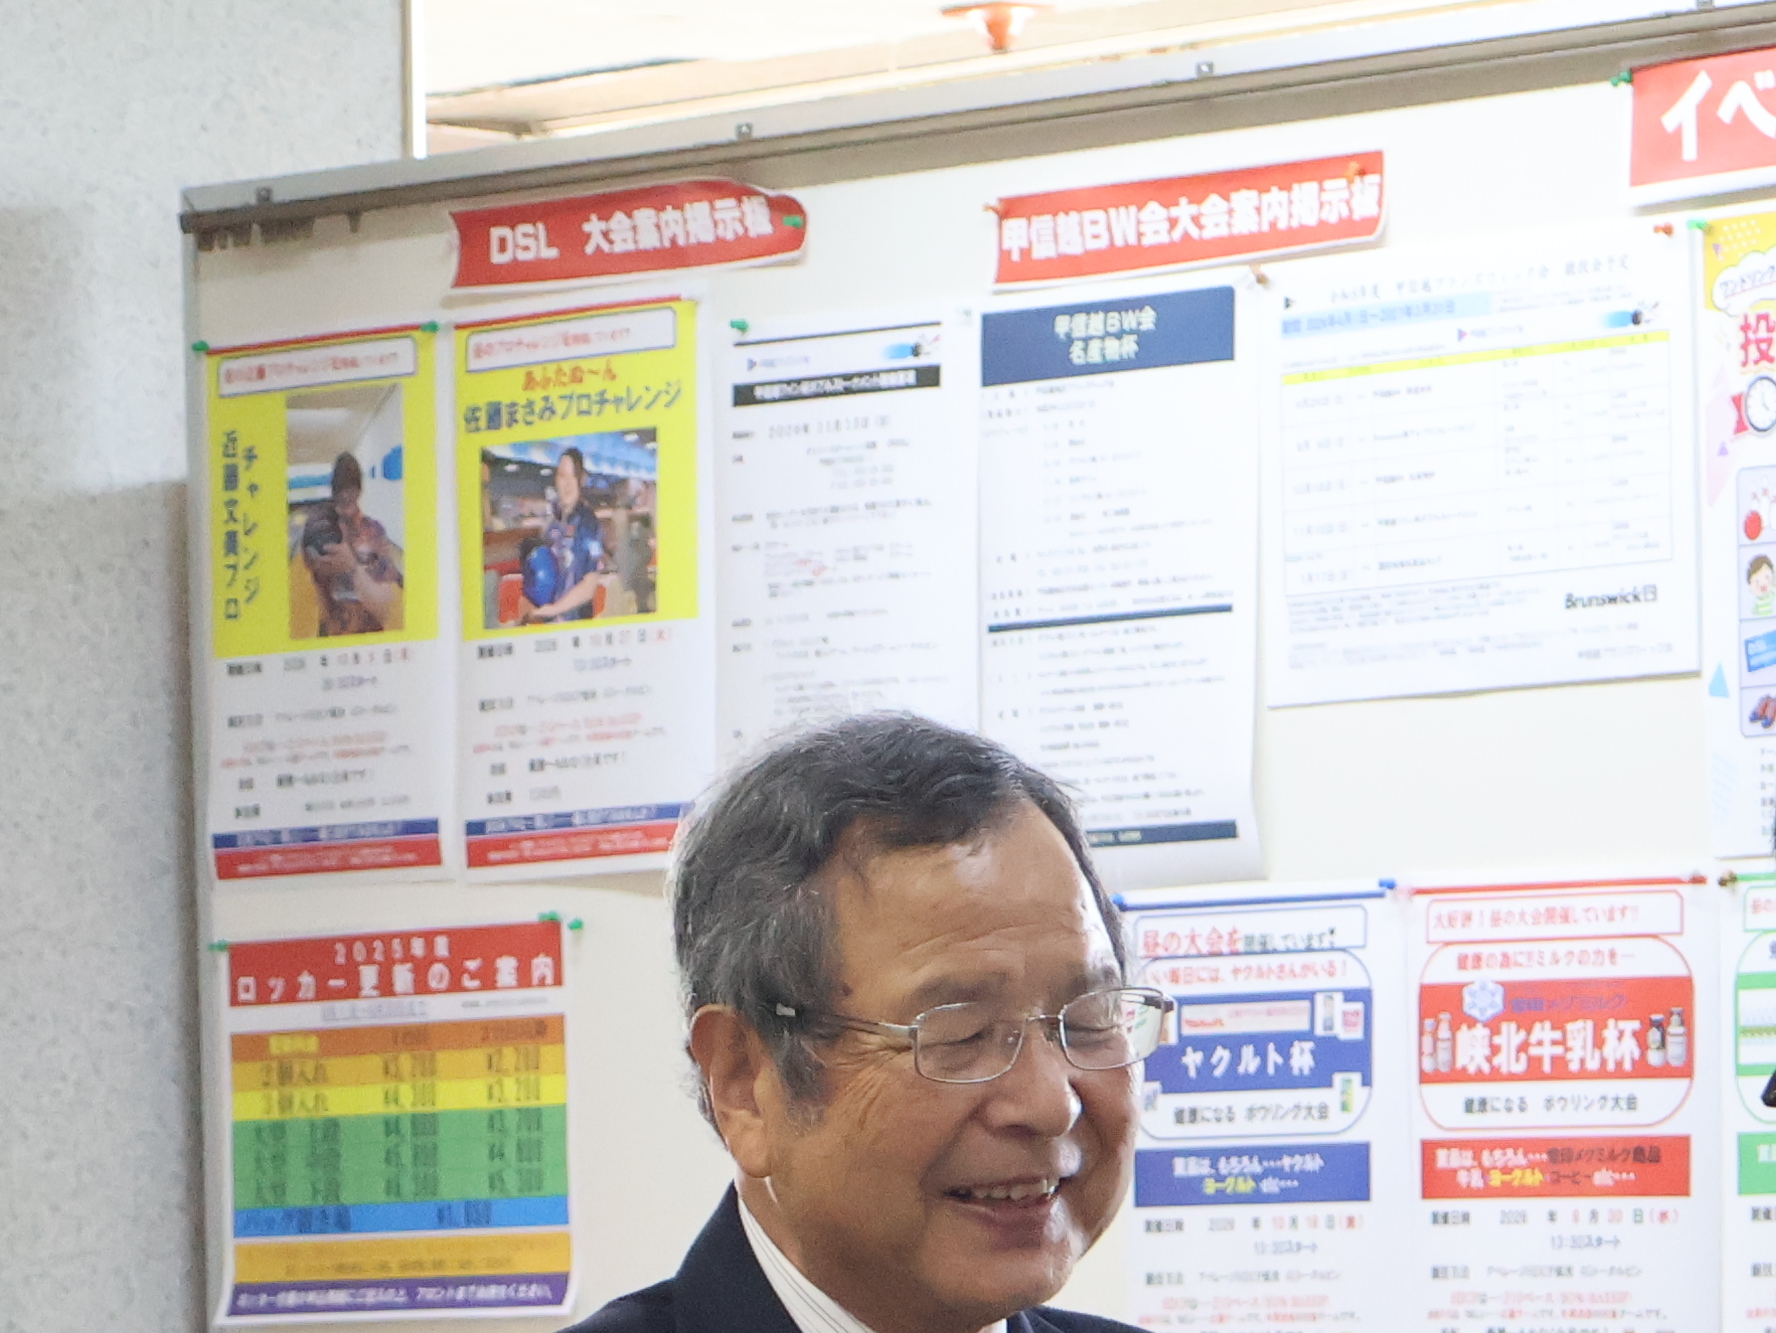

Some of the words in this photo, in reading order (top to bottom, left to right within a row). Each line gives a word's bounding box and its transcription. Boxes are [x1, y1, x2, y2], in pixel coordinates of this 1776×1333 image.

[489, 222, 560, 264] DSL
[582, 195, 774, 255] 大会案内掲示板
[1001, 172, 1382, 262] 甲信越BW会大会案内掲示板
[242, 444, 260, 604] チャレンジ
[1565, 584, 1645, 611] Brunswick
[236, 953, 555, 1003] ロッカー更新のご案内
[1180, 1039, 1316, 1079] ヤクルト杯
[1633, 1208, 1643, 1224] 日
